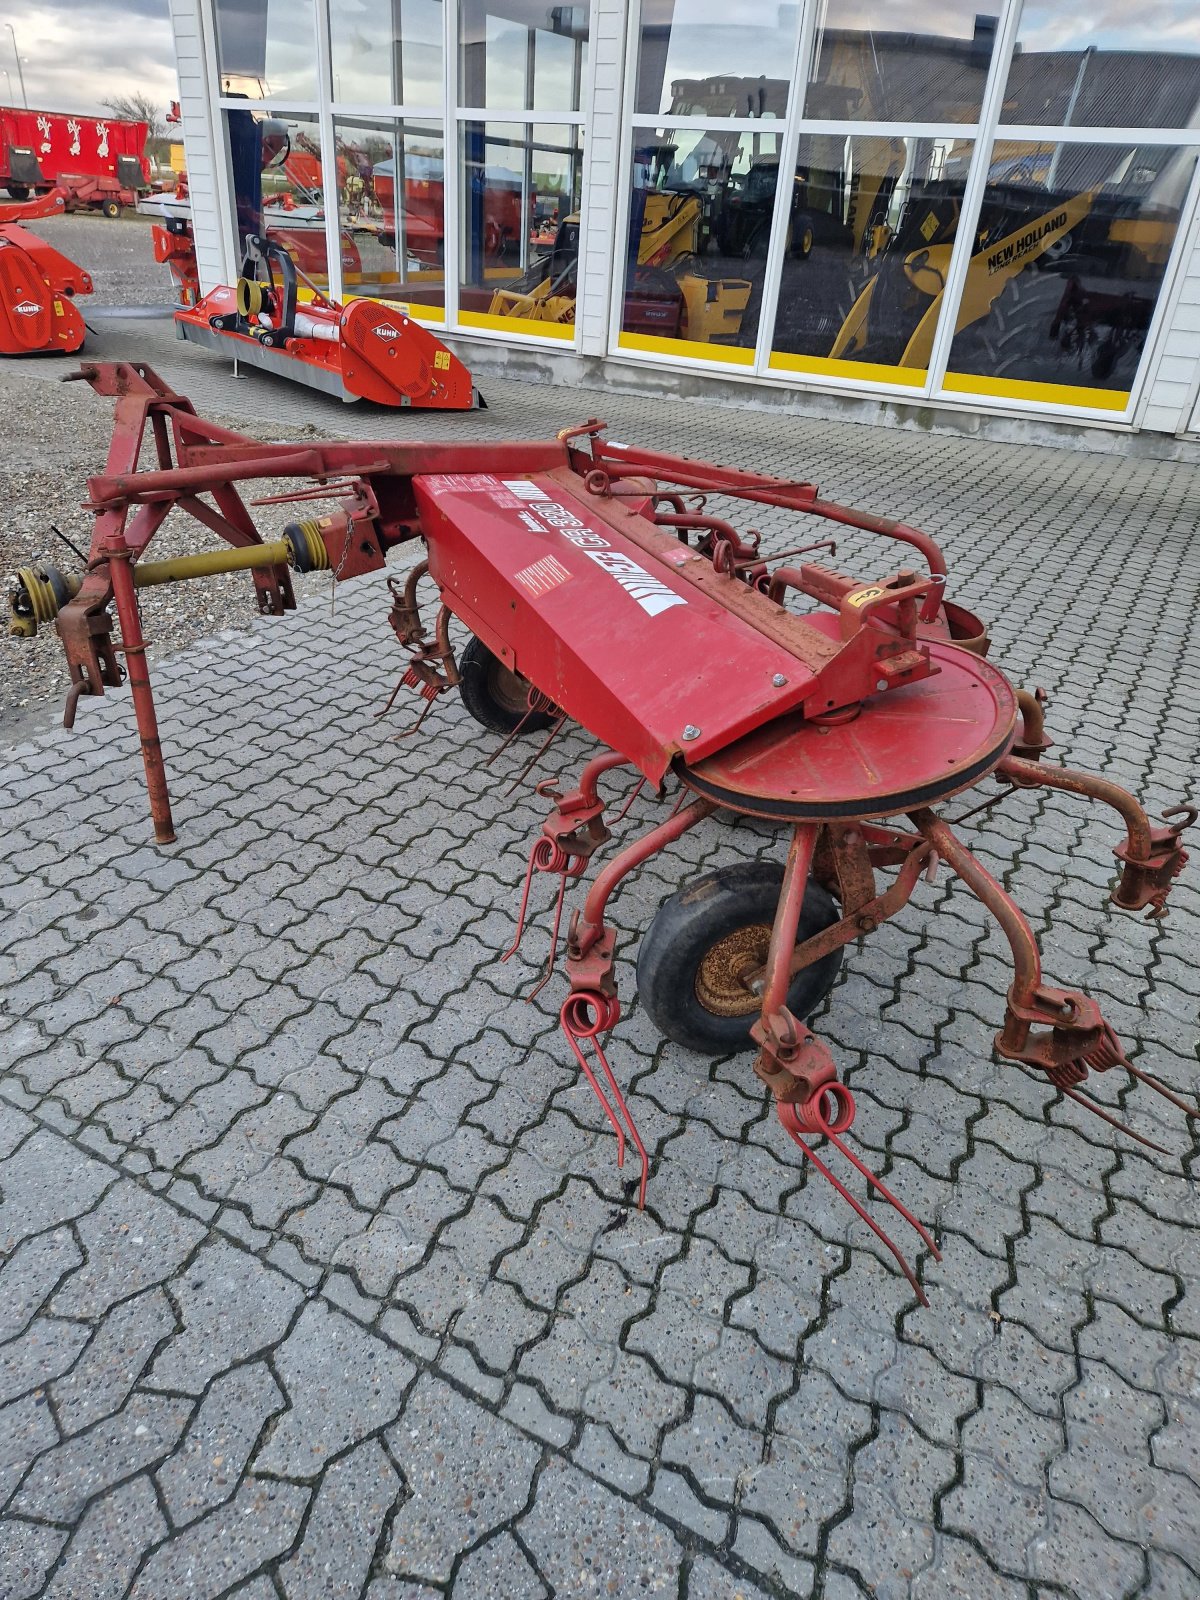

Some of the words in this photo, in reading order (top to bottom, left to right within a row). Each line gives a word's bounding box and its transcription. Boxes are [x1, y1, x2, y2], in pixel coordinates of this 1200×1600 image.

[987, 243, 1014, 270] NEW
[1016, 211, 1067, 253] HOLLAND
[989, 258, 1012, 276] LONG
[1012, 243, 1039, 262] REACH
[17, 305, 39, 313] KUHN
[376, 327, 397, 338] KUHN
[528, 503, 584, 527] 320
[559, 528, 611, 547] CR
